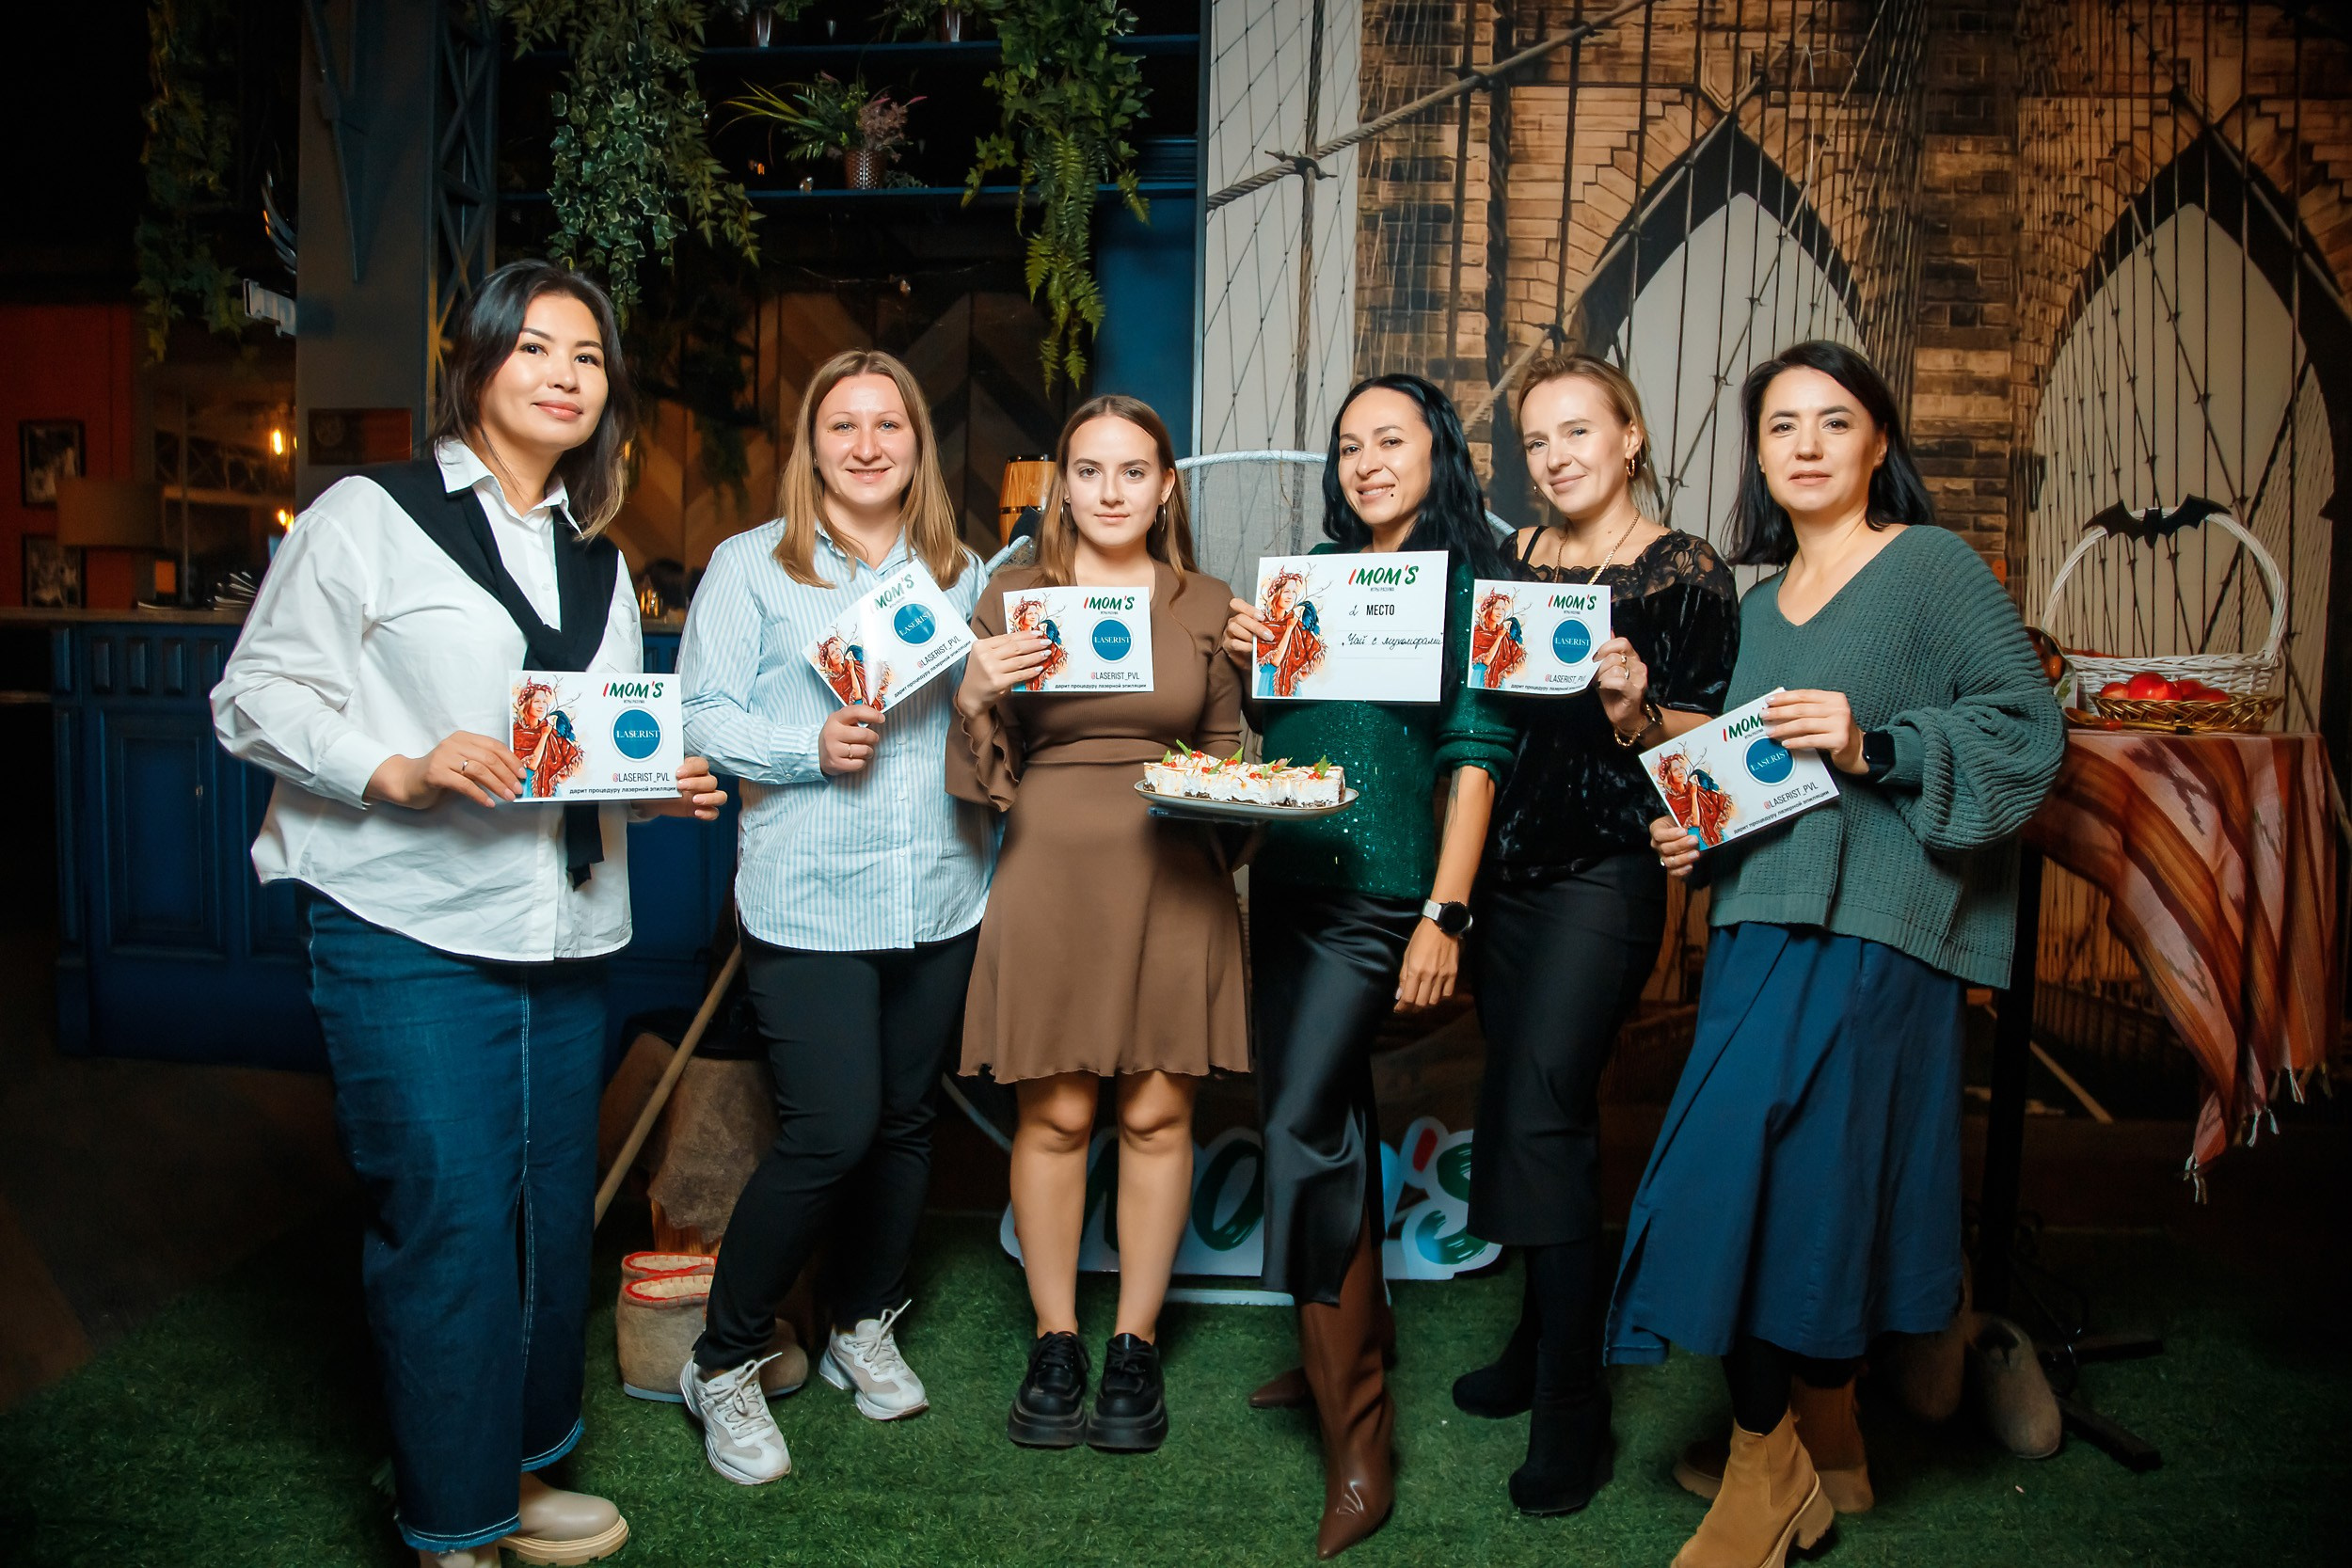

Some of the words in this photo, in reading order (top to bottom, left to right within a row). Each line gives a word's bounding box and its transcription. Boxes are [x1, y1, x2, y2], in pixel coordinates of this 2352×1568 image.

[1366, 604, 1395, 616] МЕСТО
[898, 610, 931, 637] LASERIST
[1555, 637, 1590, 647] LASERIST
[1090, 672, 1140, 681] @LASERIST_PVL
[616, 730, 659, 738] LASERIST
[612, 772, 670, 783] @LASERIST_PVL
[1763, 782, 1819, 810] @LASERIST_PVL
